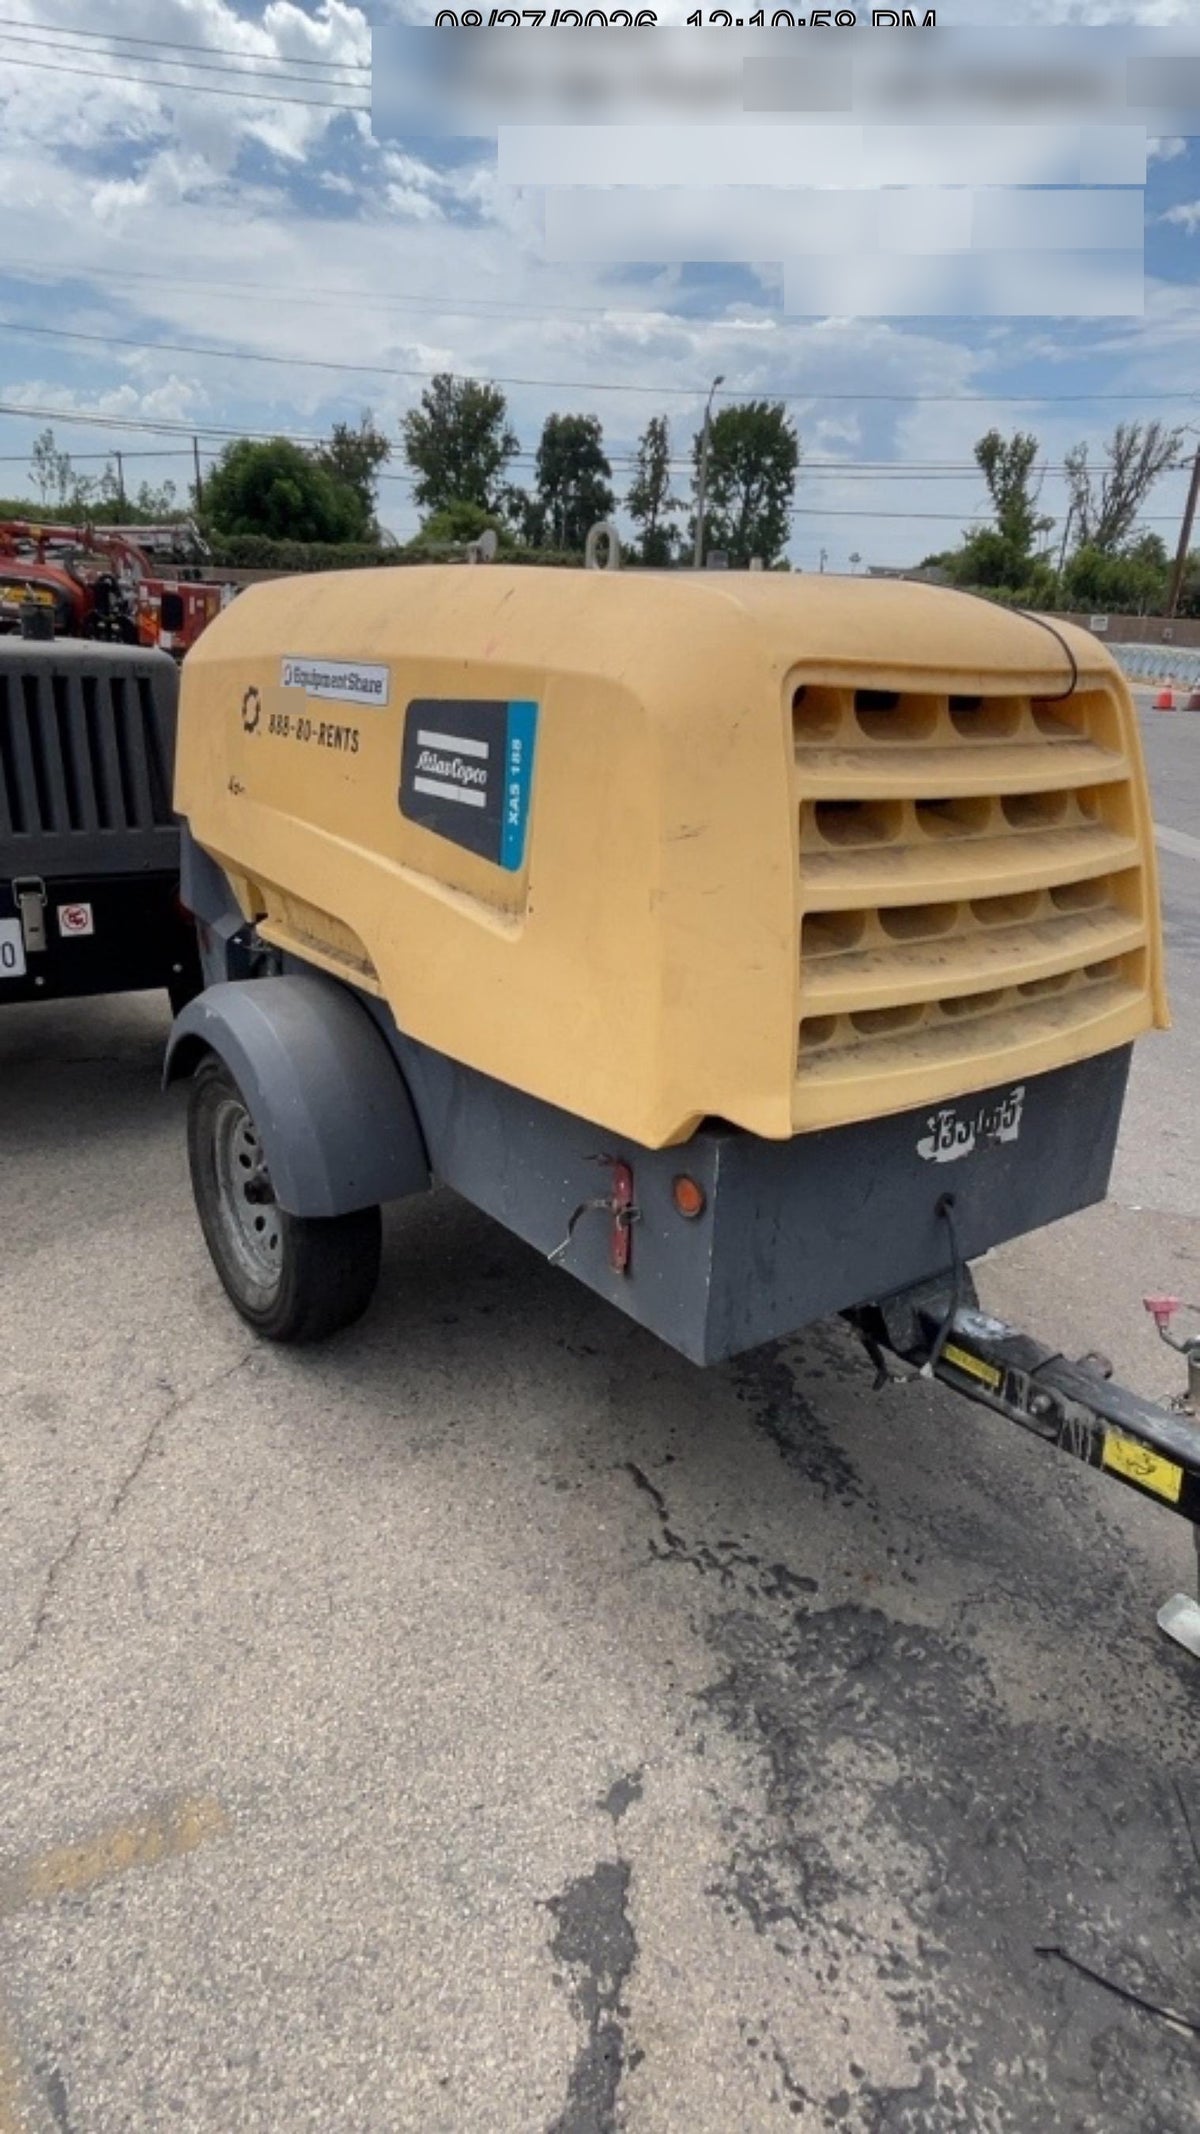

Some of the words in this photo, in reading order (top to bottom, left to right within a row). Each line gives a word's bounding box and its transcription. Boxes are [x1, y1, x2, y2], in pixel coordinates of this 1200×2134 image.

[293, 666, 383, 694] EquipmentShare
[268, 714, 360, 754] 888-80-RENTS
[508, 783, 521, 826] XAS
